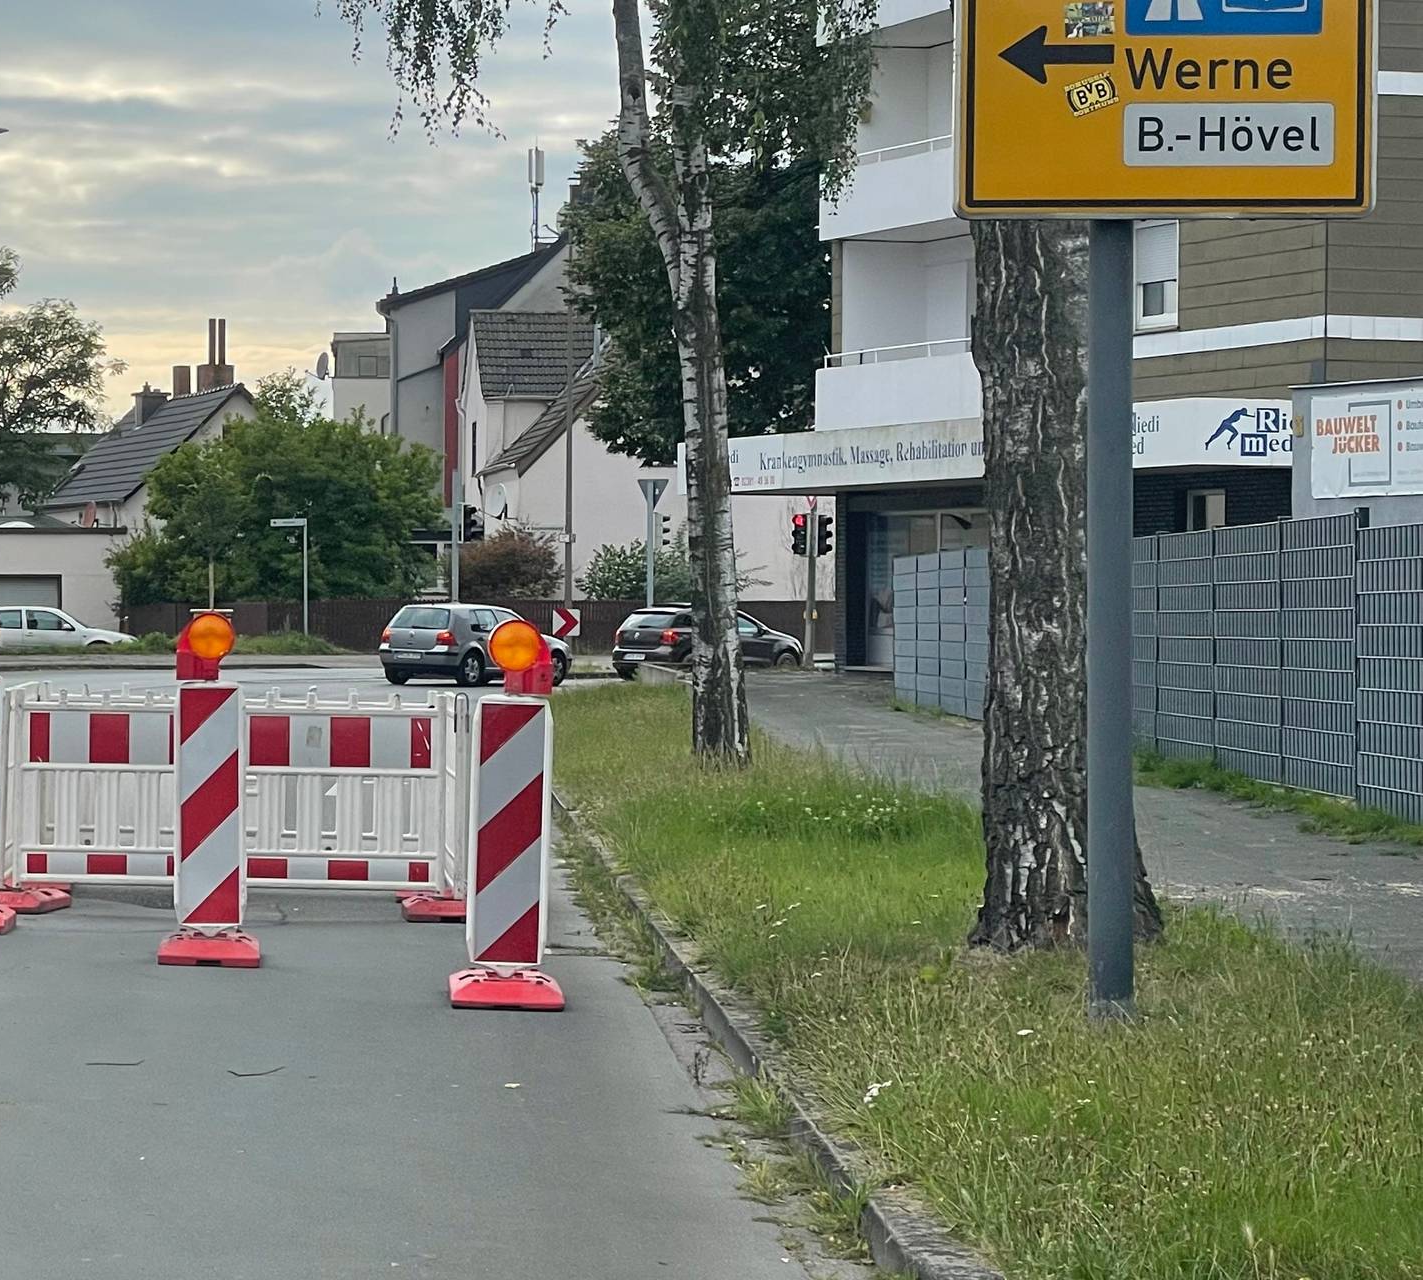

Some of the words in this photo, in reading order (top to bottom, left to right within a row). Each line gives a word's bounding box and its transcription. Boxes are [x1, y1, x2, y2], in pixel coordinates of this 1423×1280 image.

[1125, 48, 1293, 90] Werne
[1076, 82, 1108, 105] BVB
[1139, 116, 1320, 152] B.-Hövel
[1316, 415, 1377, 436] BAUWELT
[850, 445, 893, 468] Massage,
[896, 438, 967, 461] Rehabilitation
[971, 441, 984, 456] un
[1241, 434, 1293, 455] med
